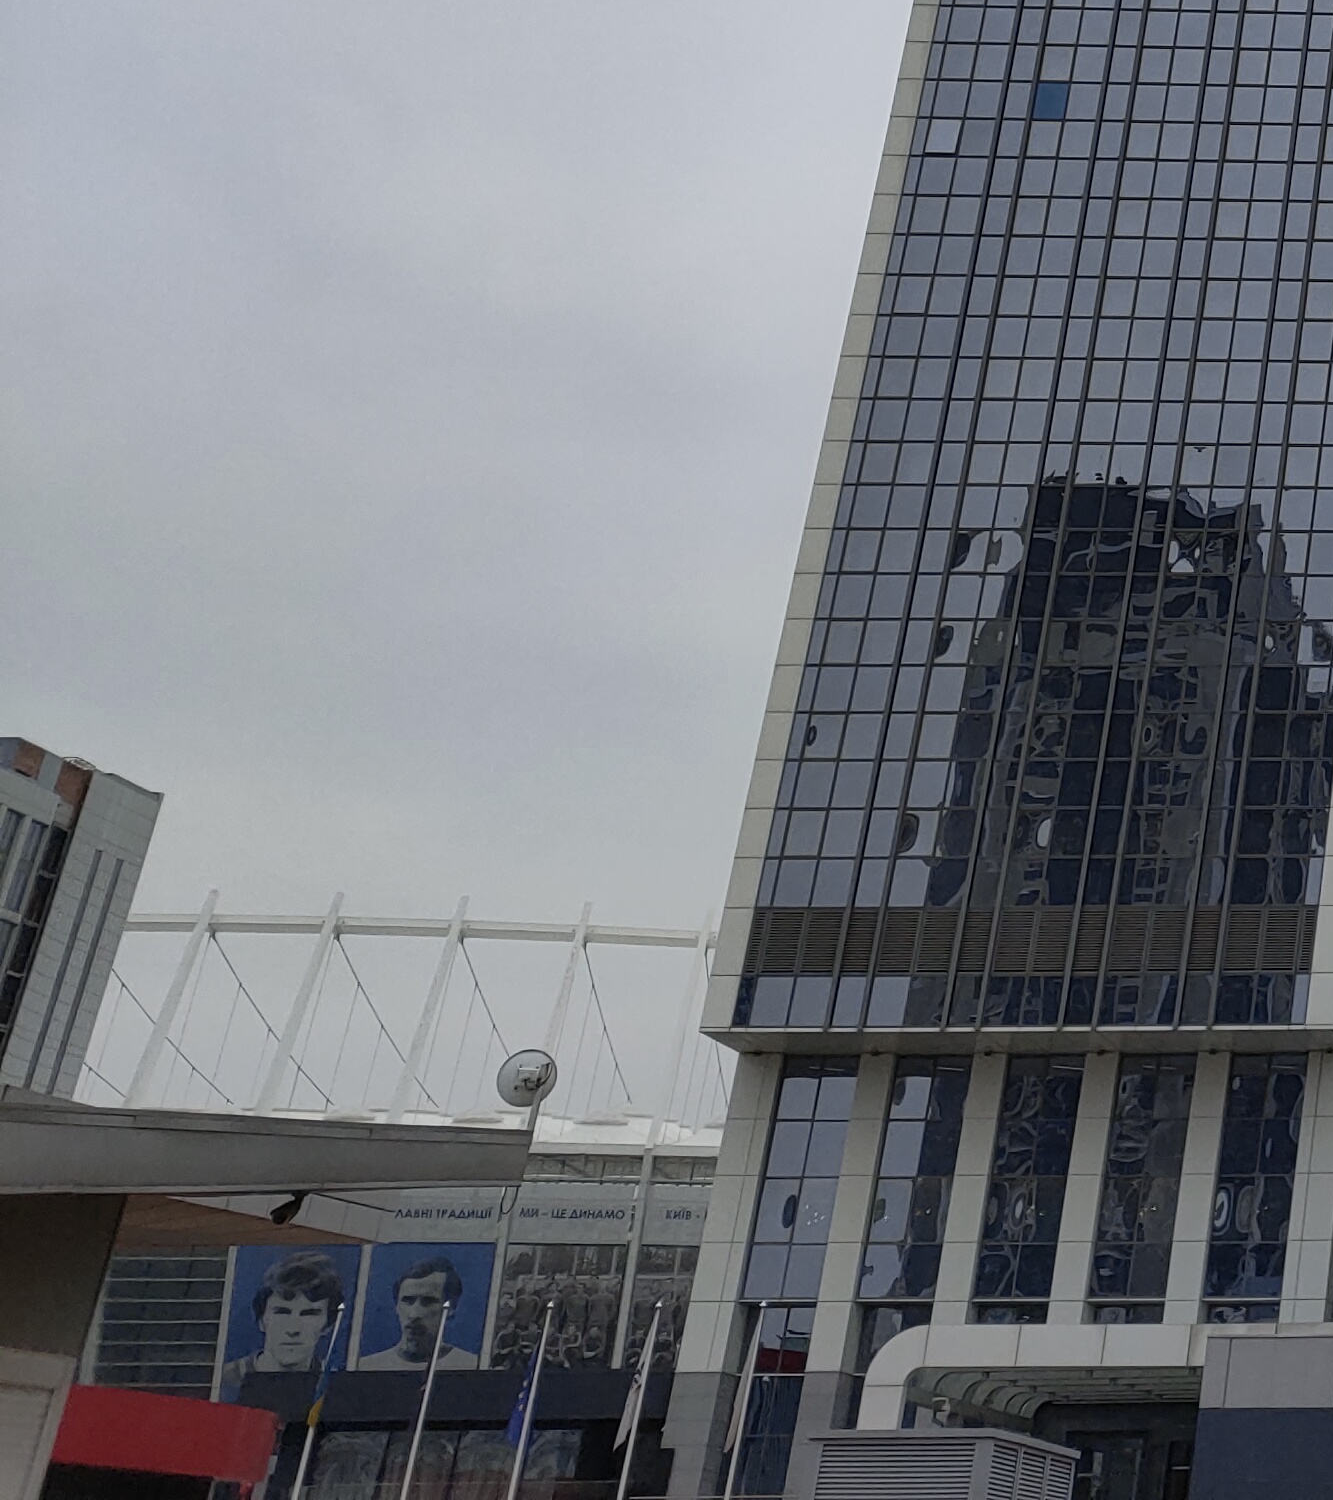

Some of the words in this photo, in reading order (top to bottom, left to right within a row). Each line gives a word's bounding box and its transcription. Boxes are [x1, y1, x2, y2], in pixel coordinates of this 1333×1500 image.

[394, 1208, 433, 1219] ЛАВНІ
[519, 1207, 539, 1218] МИ
[551, 1208, 567, 1220] ЦЕ
[568, 1208, 625, 1220] ДИНАМО
